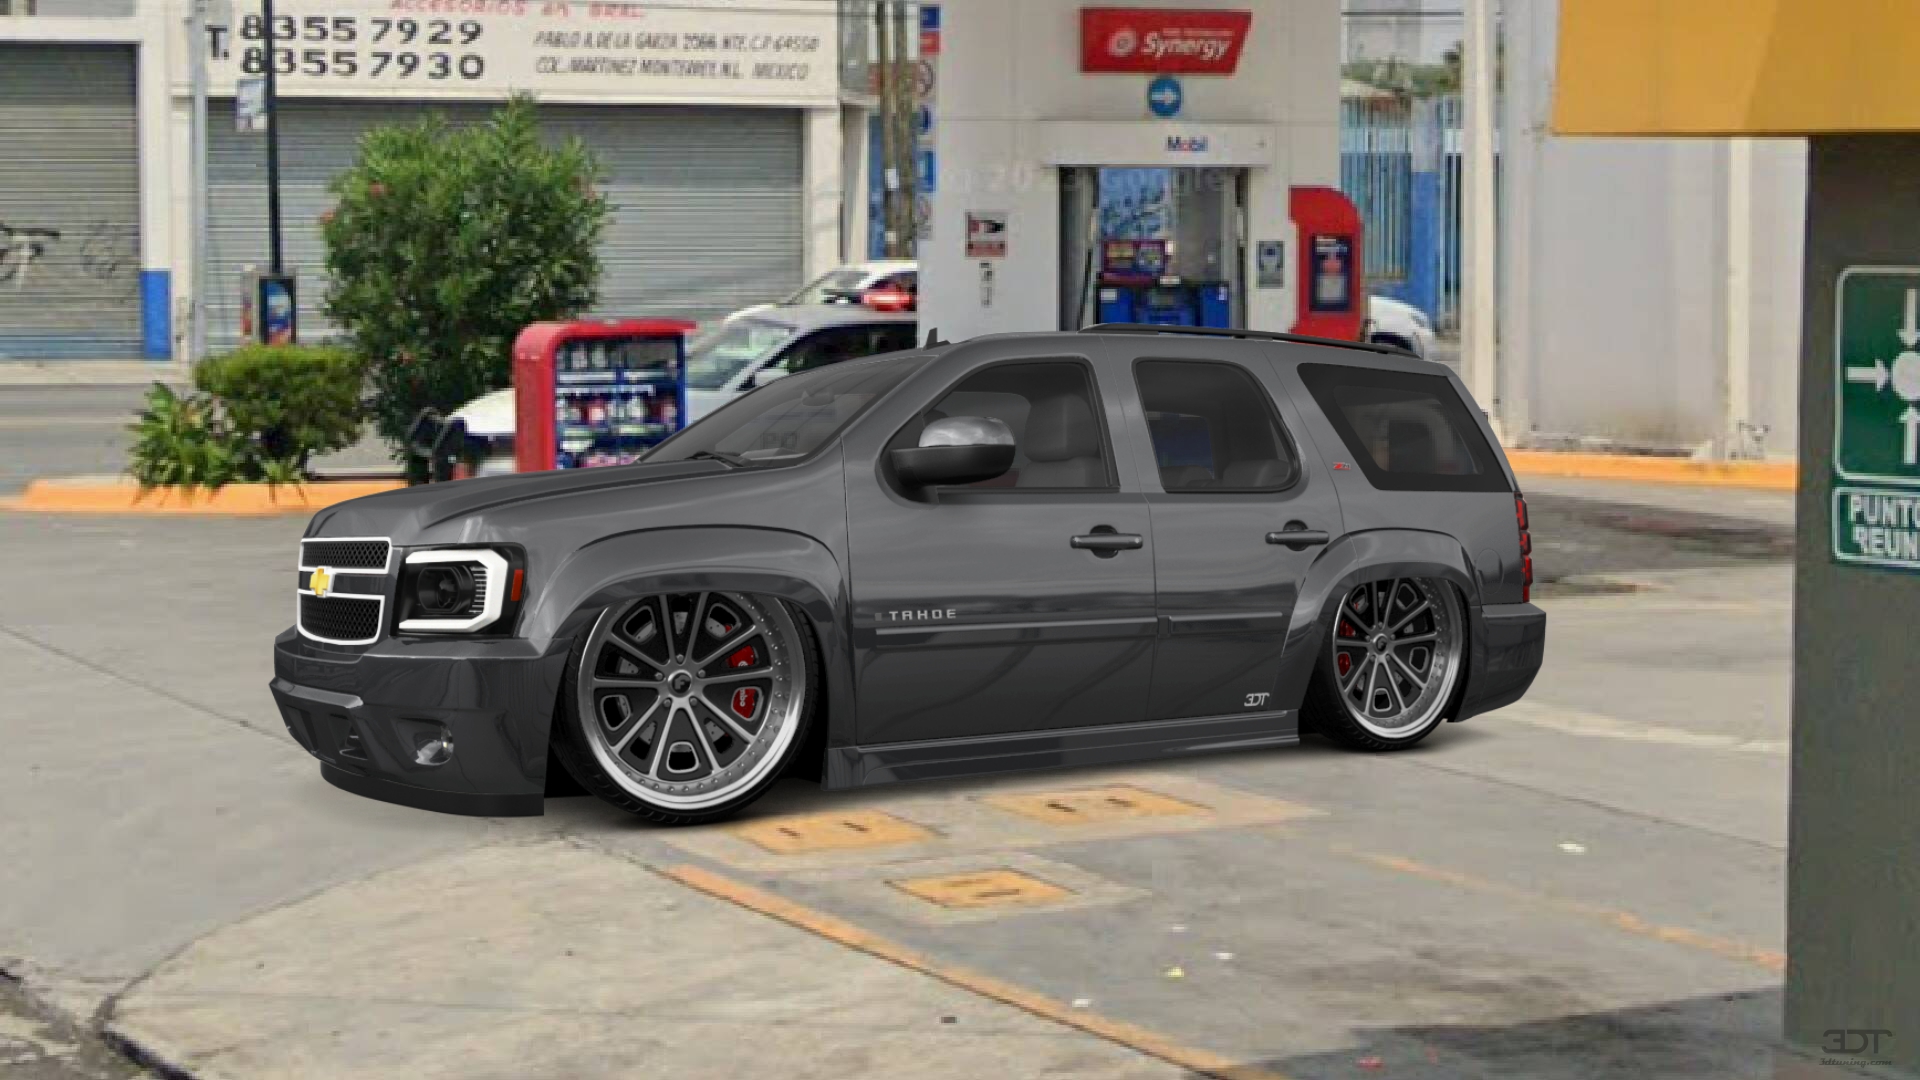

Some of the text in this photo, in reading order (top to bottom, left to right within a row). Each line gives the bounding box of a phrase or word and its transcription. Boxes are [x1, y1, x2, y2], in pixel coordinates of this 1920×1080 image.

[1141, 32, 1232, 61] Synergy
[1167, 136, 1208, 151] Mobil
[888, 608, 957, 622] TAHOE
[1243, 692, 1270, 707] 3DT
